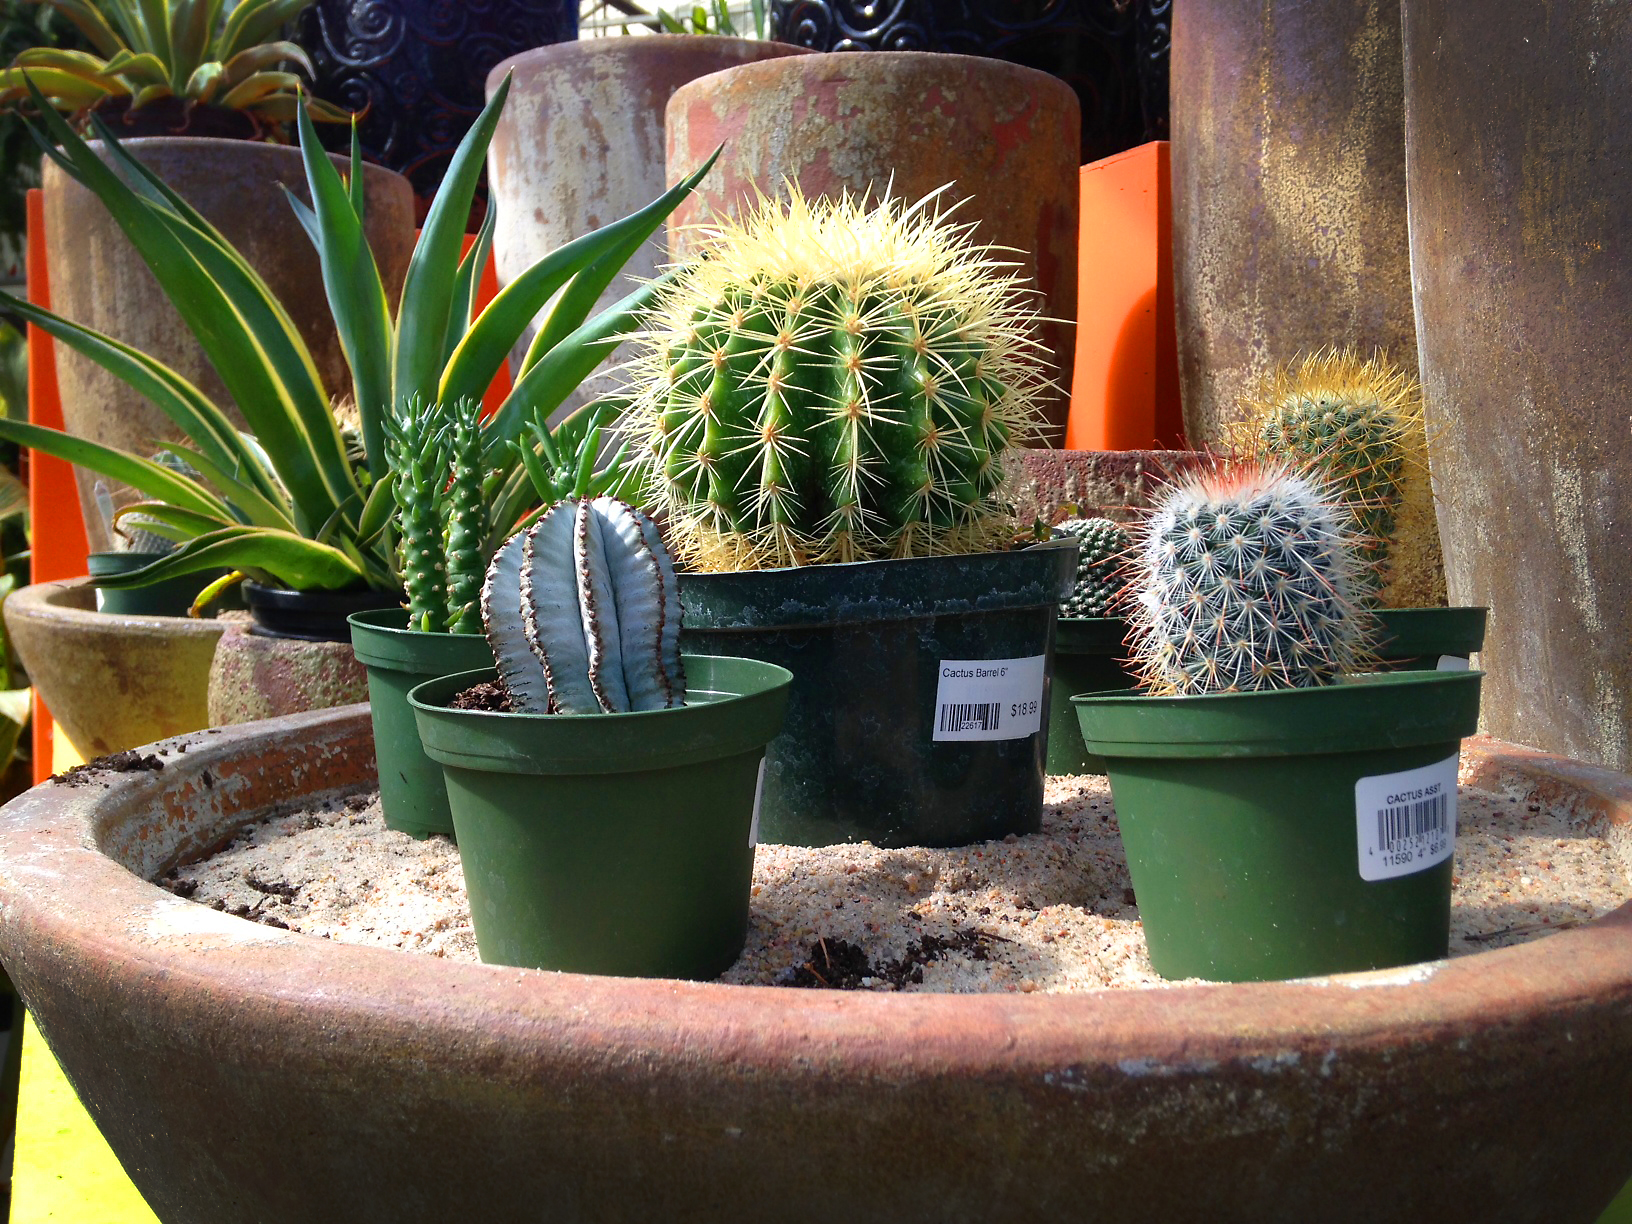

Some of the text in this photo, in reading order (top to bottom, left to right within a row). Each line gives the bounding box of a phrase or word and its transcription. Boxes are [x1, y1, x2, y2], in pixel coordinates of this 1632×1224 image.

[942, 667, 974, 678] Cactus
[976, 667, 999, 678] Barrel
[1010, 700, 1038, 718] $18.99
[960, 721, 982, 730] 22617
[1386, 782, 1442, 805] CACTUS ASST
[1382, 851, 1413, 867] 11590
